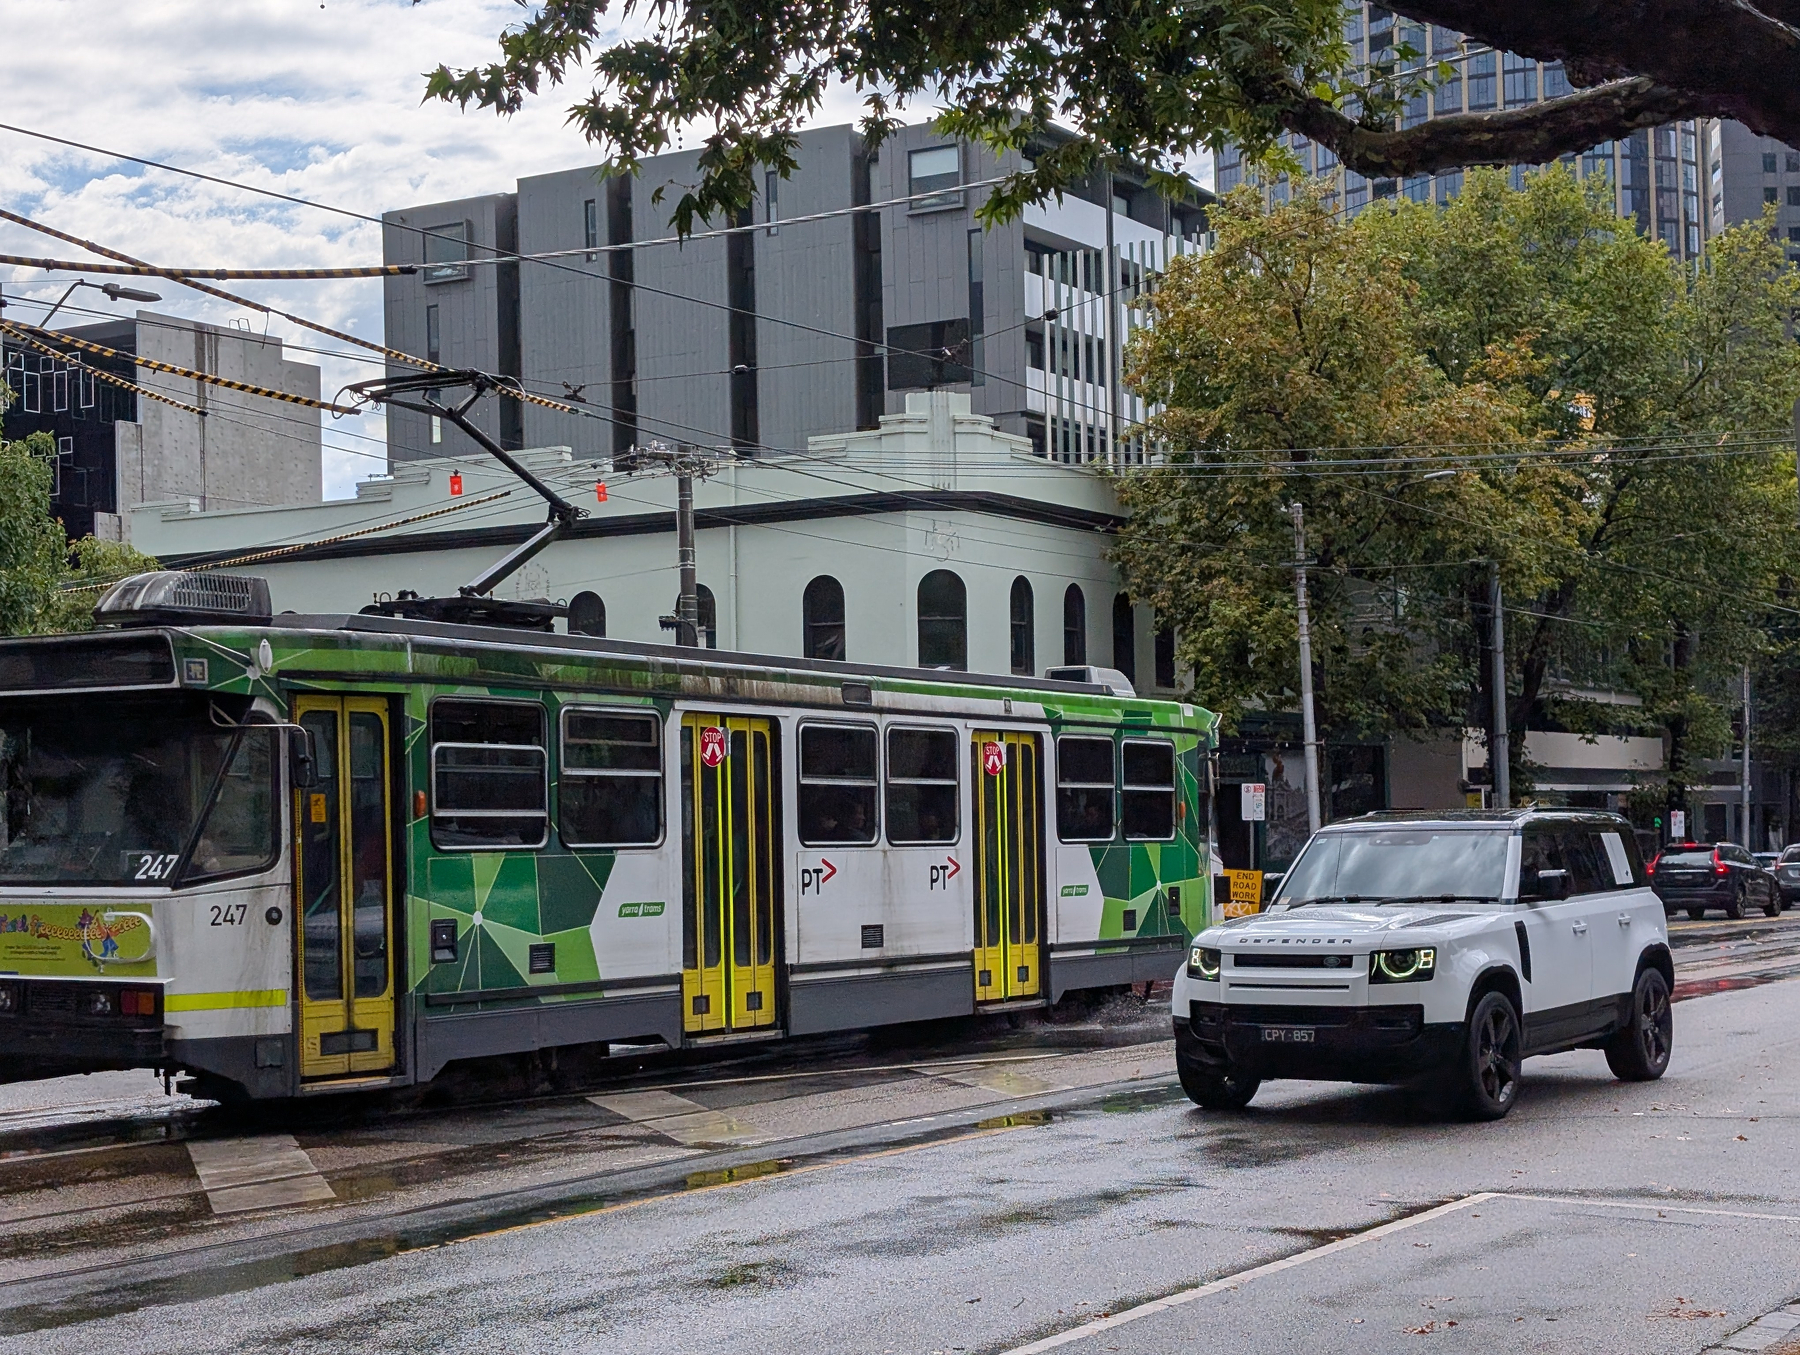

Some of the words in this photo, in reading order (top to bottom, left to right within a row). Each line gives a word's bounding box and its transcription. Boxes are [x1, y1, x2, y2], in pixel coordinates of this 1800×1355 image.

[704, 732, 722, 743] STOP
[985, 746, 1000, 755] STOP
[135, 854, 180, 880] 247
[801, 868, 824, 895] PT
[930, 865, 949, 890] PT
[1236, 872, 1255, 880] END
[1232, 881, 1257, 890] ROAD
[1231, 891, 1256, 900] WORK
[210, 904, 247, 926] 247
[621, 906, 639, 916] yarra
[644, 904, 662, 913] trams
